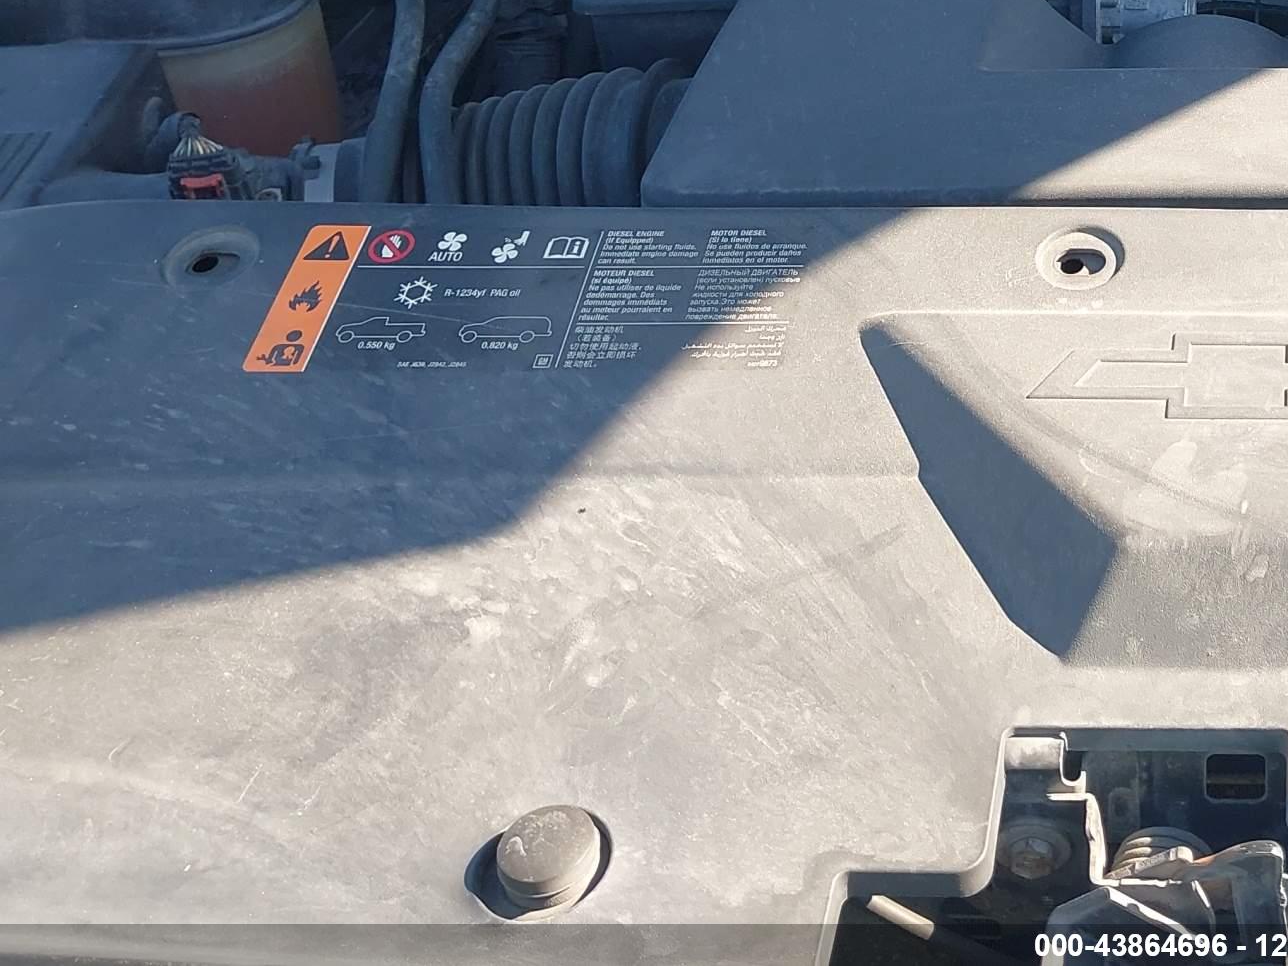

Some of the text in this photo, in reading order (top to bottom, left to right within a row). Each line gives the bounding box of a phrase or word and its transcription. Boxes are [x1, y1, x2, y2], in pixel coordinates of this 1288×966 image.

[428, 251, 463, 262] AUTO
[698, 268, 799, 276] ДИЗЕЛЬНЫЙ ДВИГАТЕЛЬ
[444, 288, 521, 297] R-1234yf PAG oil
[357, 341, 396, 350] 0.550 kg
[481, 341, 519, 350] 0.820 kg
